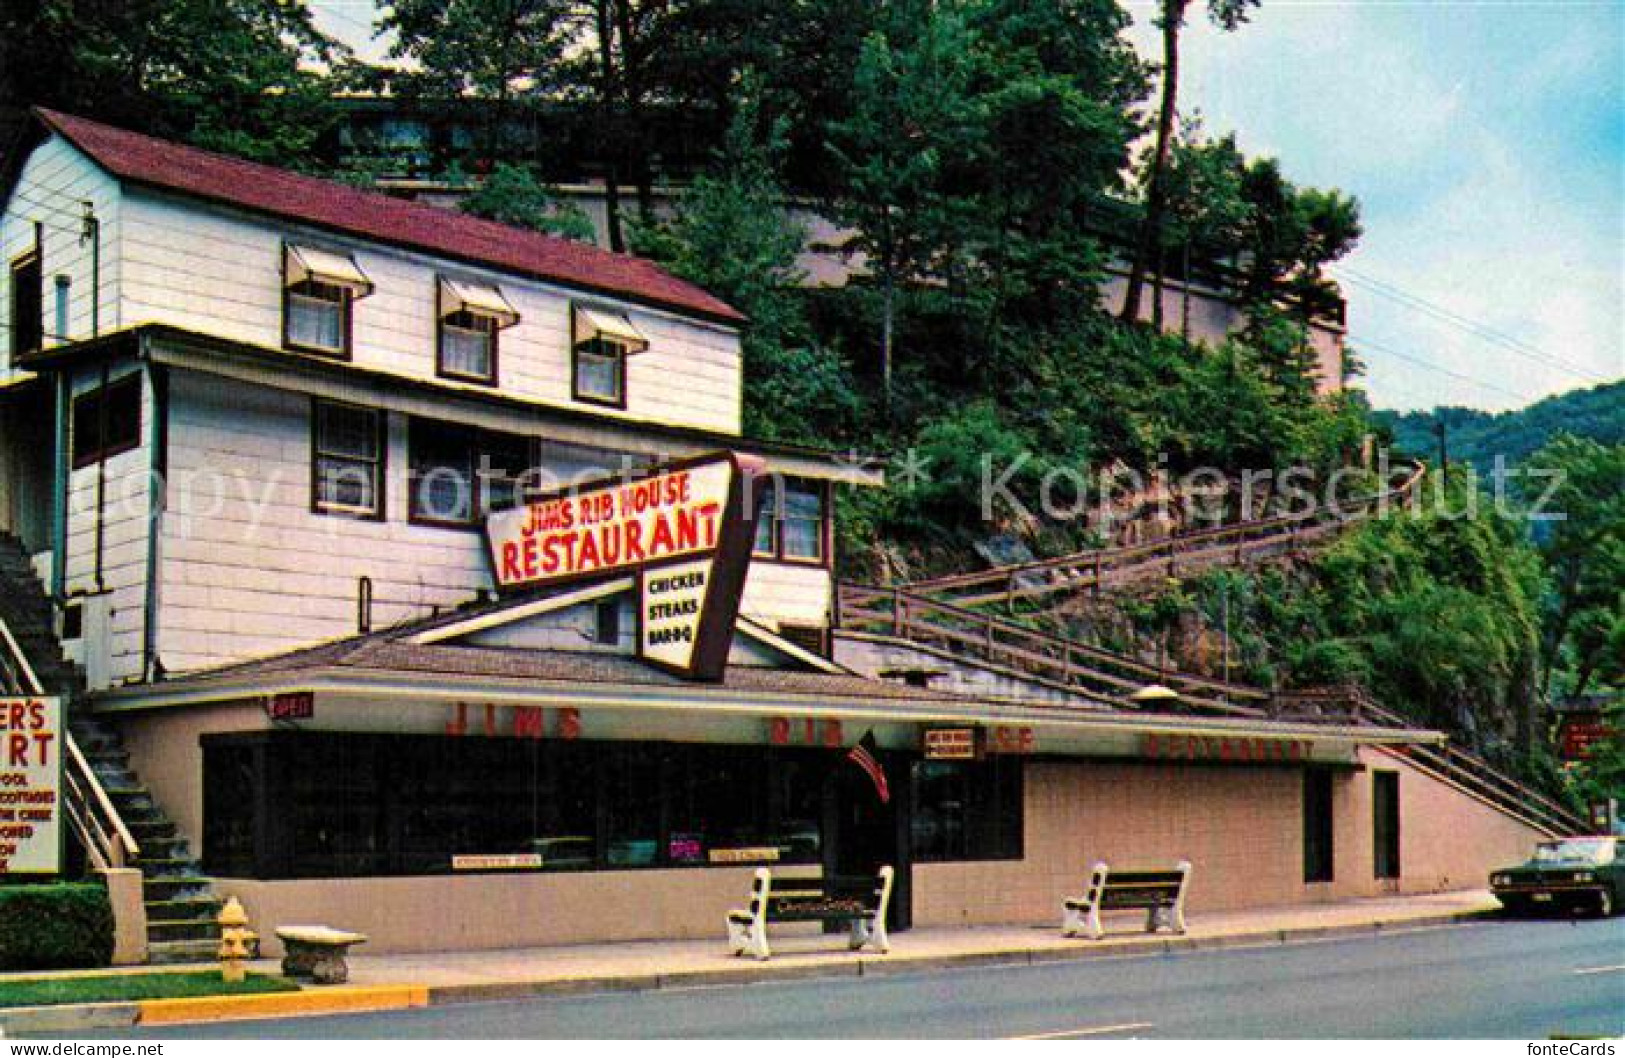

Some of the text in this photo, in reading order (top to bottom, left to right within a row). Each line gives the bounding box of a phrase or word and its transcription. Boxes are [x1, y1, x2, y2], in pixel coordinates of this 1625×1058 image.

[580, 493, 614, 526] RIB
[621, 472, 691, 518] HOUSE
[503, 502, 720, 581] RESTAURANT
[648, 572, 704, 595] CHICKEN
[648, 599, 698, 621] STEAKS
[445, 701, 843, 748] JIMS RIB
